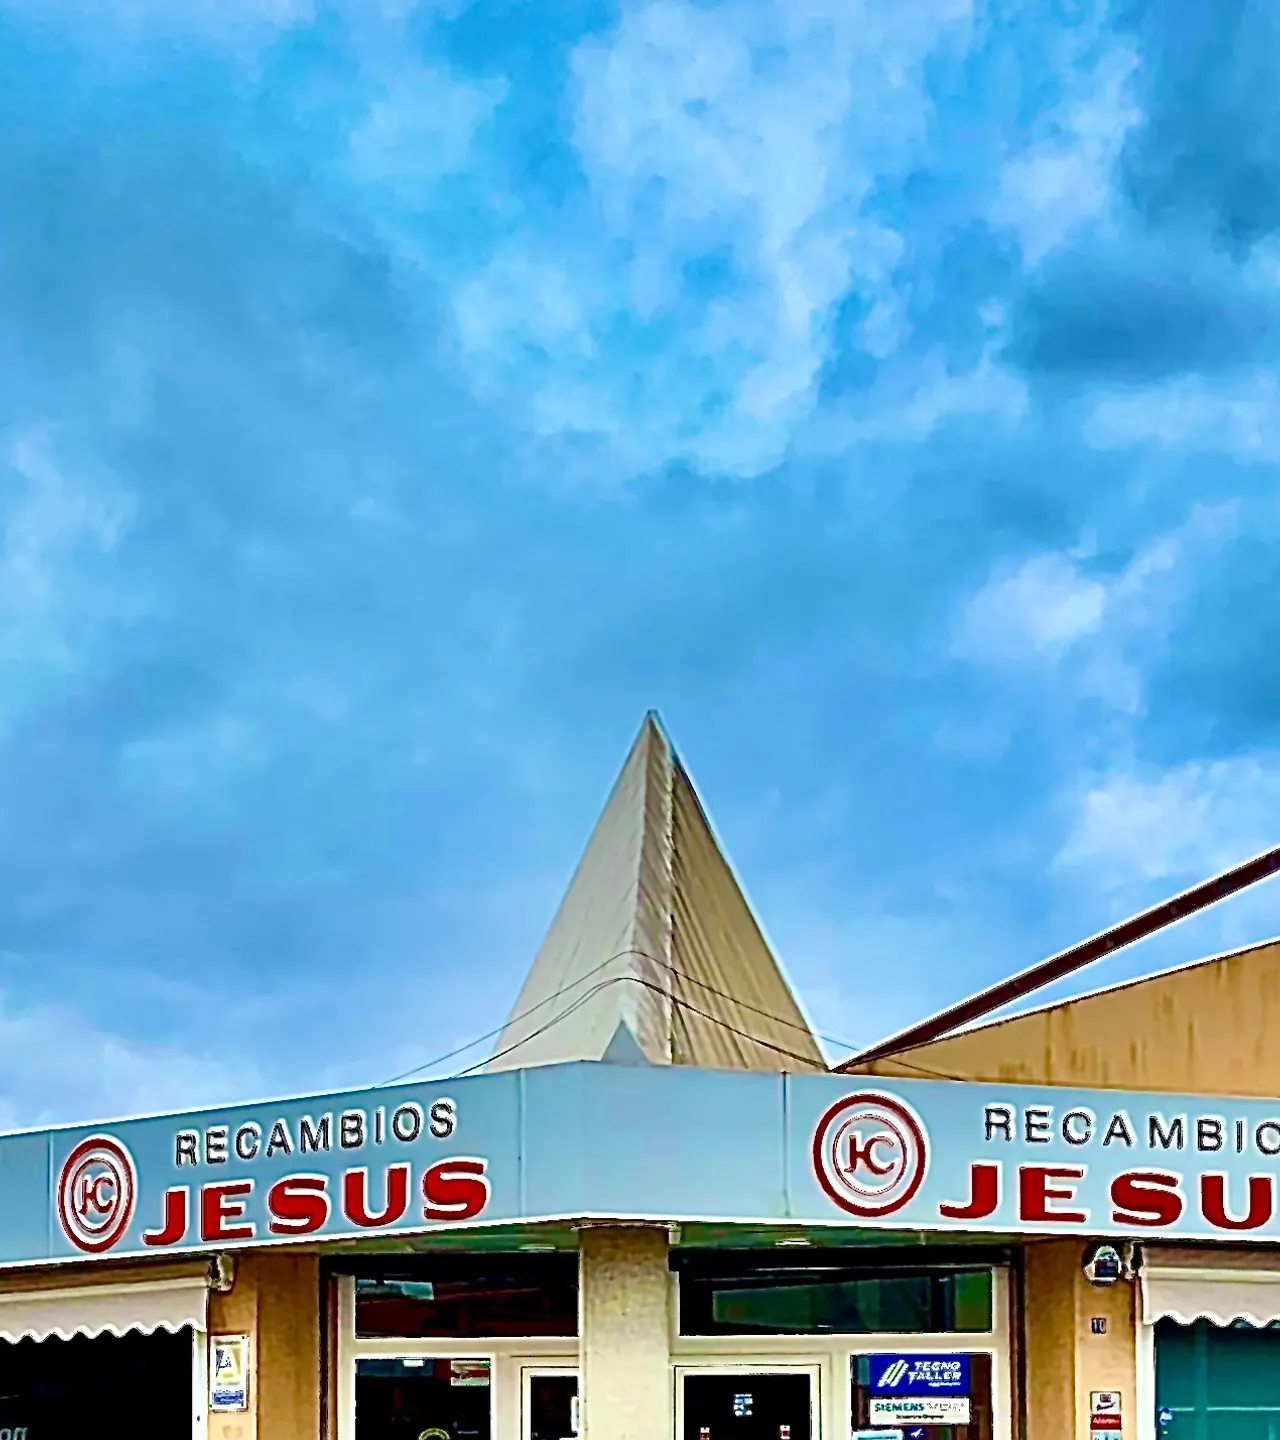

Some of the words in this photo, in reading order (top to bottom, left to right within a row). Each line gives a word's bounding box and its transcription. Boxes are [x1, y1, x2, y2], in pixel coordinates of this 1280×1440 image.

[175, 1102, 455, 1167] RECAMBIOS
[142, 1160, 488, 1247] JESUS
[914, 1361, 962, 1371] TECNO
[908, 1371, 962, 1385] TALLER
[874, 1402, 925, 1412] SIEMENS
